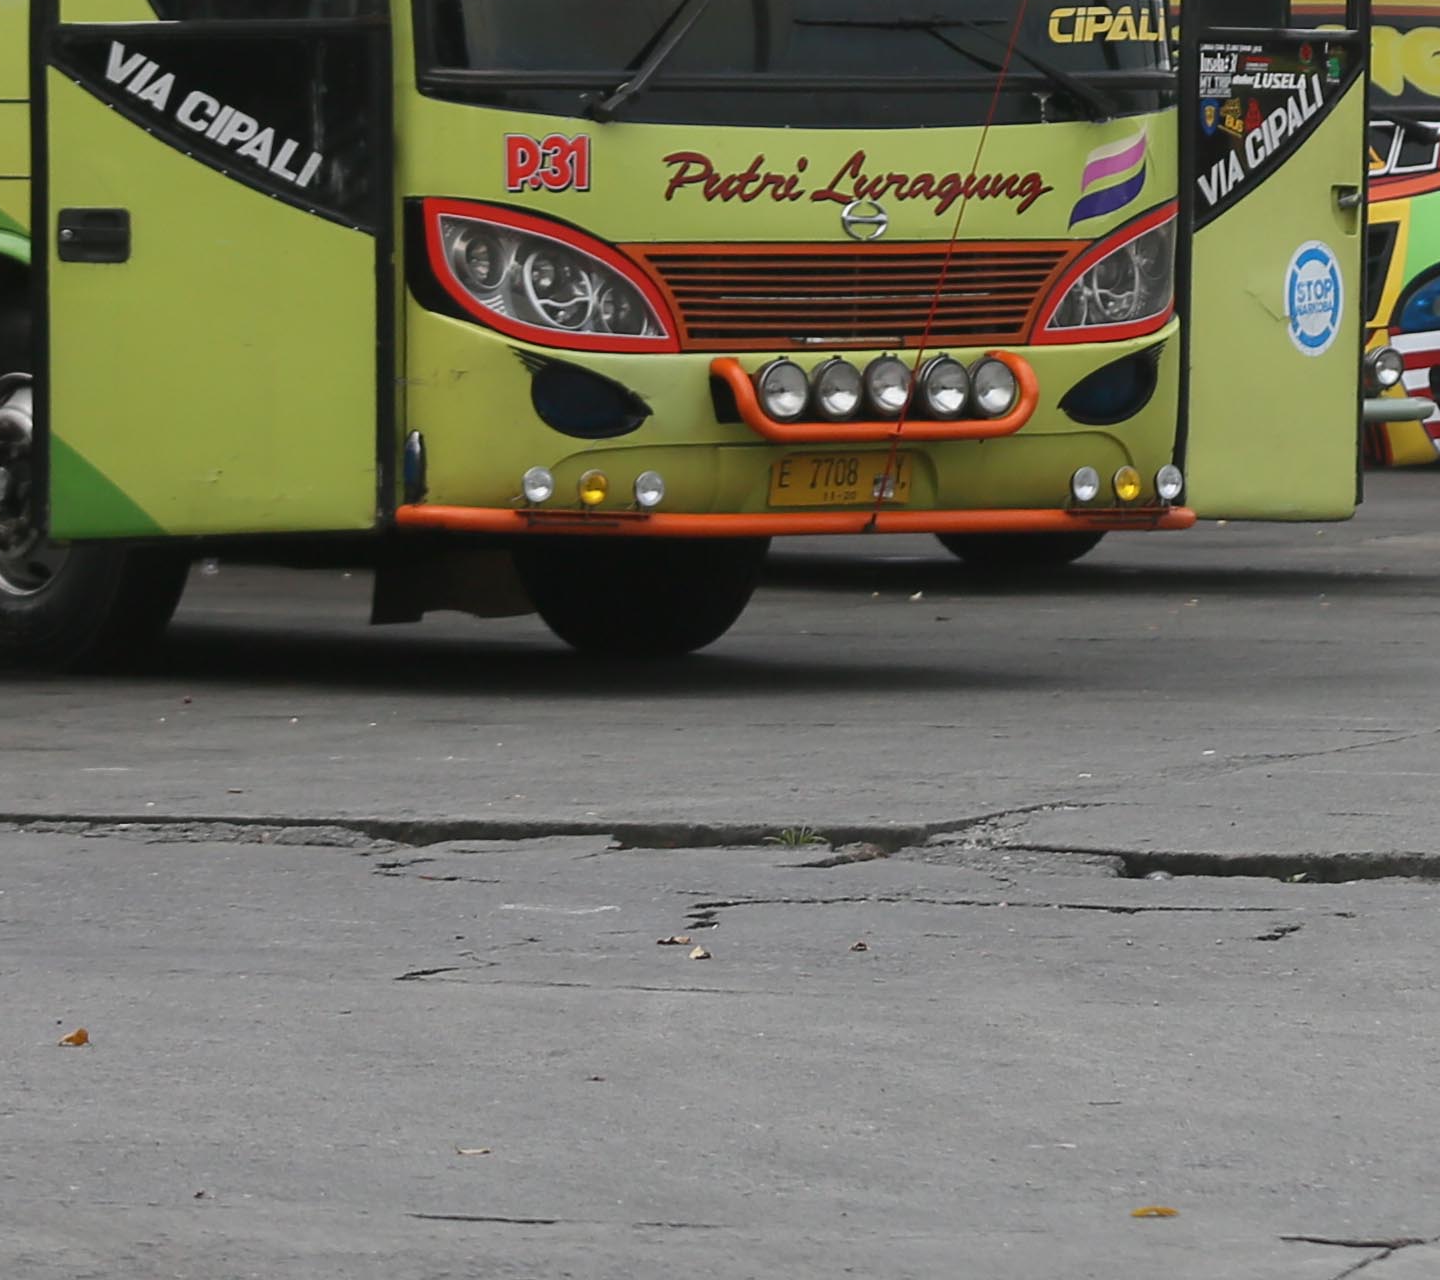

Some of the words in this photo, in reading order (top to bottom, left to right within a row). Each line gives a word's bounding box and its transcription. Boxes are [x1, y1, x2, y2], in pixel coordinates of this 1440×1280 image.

[1048, 5, 1166, 44] CIPALI
[1254, 72, 1307, 90] LUSELA
[105, 40, 169, 111] VIA
[175, 90, 324, 188] CIPALI
[504, 133, 590, 192] P.31
[1197, 149, 1245, 206] VIA
[1244, 73, 1324, 169] CIPALI
[662, 149, 809, 206] Putri
[811, 148, 1054, 215] Luragung
[1297, 278, 1332, 303] STOP
[778, 459, 792, 488] E
[810, 457, 859, 489] 7708
